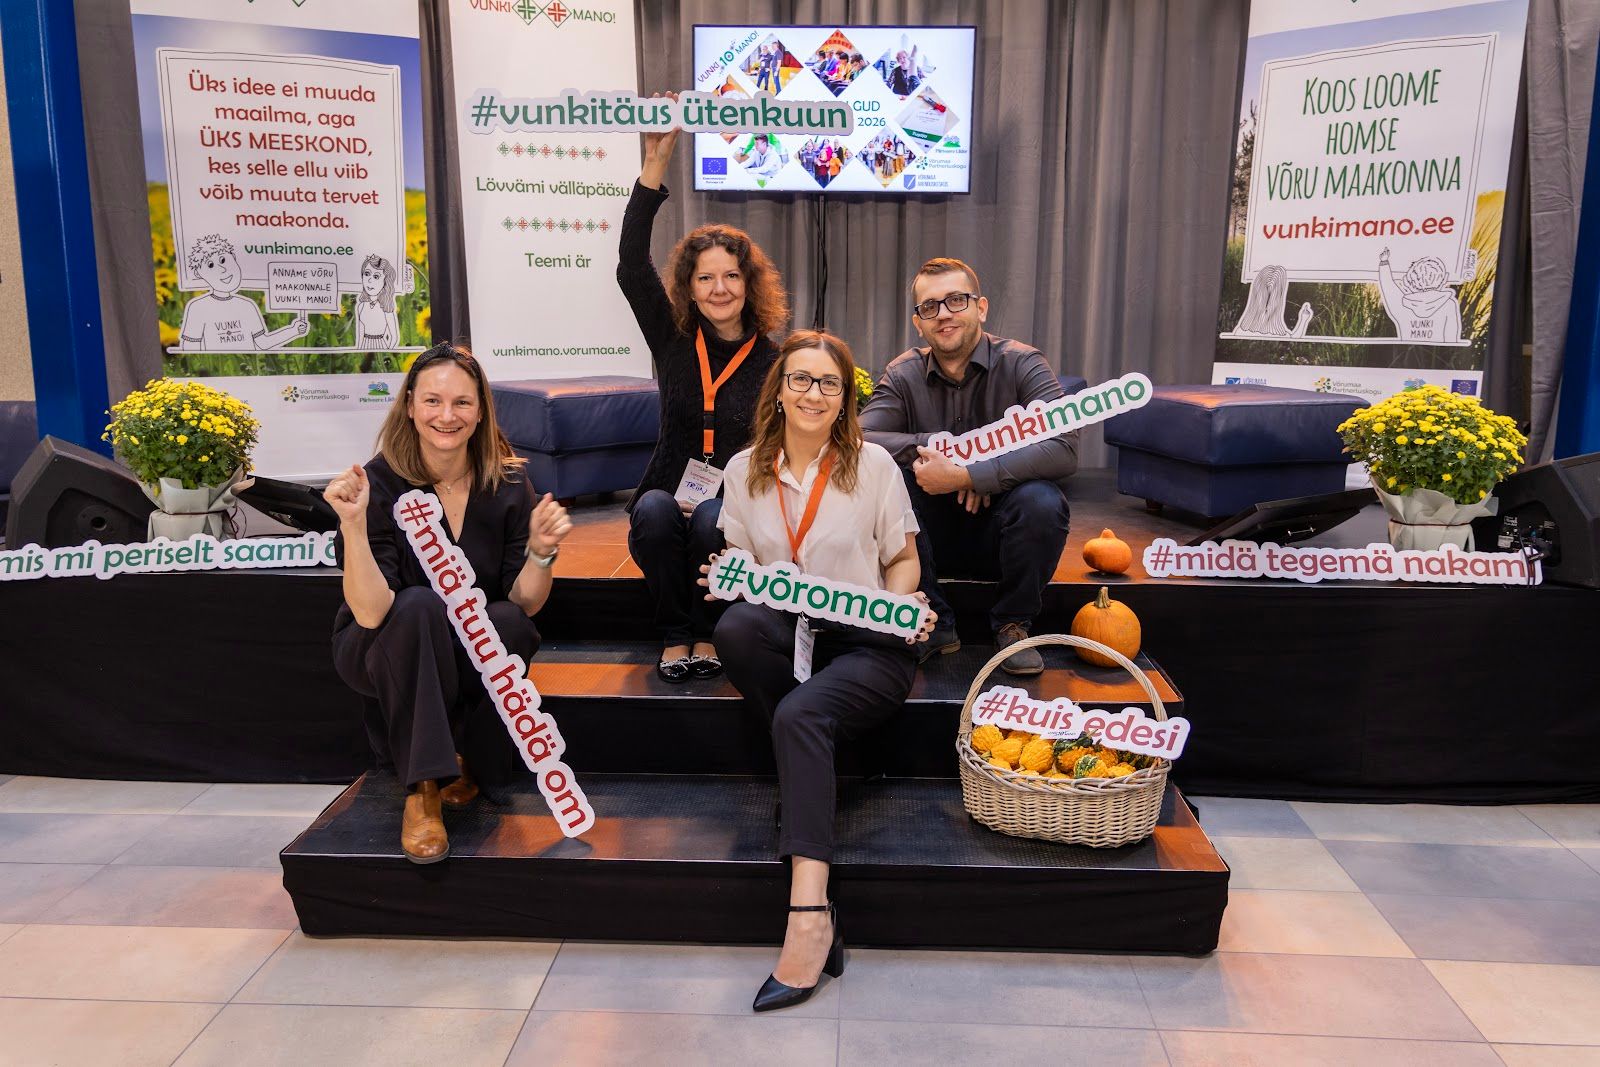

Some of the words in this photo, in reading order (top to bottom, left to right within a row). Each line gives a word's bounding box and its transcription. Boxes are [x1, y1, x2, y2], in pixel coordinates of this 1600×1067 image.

[470, 0, 511, 13] VUNKI
[573, 8, 616, 24] MANO!
[697, 61, 720, 83] VUNKI
[735, 30, 760, 54] MANO!
[188, 69, 227, 93] Üks
[233, 77, 276, 96] idee
[282, 82, 299, 98] ei
[304, 85, 376, 103] muuda
[1302, 75, 1357, 116] KOOS
[1363, 69, 1442, 110] LOOME
[215, 105, 312, 127] maailma,
[318, 111, 356, 129] aga
[471, 95, 673, 127] #vunkitäus
[683, 97, 847, 129] ütenkuun
[857, 117, 886, 127] 2026
[200, 126, 242, 149] ÜKS
[249, 132, 373, 157] MEESKOND,
[1326, 117, 1400, 156] HOMSE
[208, 156, 241, 175] kes
[248, 159, 288, 177] selle
[294, 161, 328, 178] ellu
[334, 163, 368, 180] viib
[1267, 162, 1319, 201] VÕRU
[1324, 156, 1461, 199] MAAKONNA
[200, 183, 244, 202] võib
[250, 187, 317, 203] muuta
[322, 188, 380, 205] tervet
[476, 176, 545, 194] Lövvämi
[549, 180, 630, 198] välläpääsu
[236, 211, 350, 229] maakonda.
[1262, 216, 1455, 240] vunkimano.ee
[243, 242, 355, 256] vunkimano.ee
[524, 252, 571, 268] Teemi
[575, 254, 592, 268] är
[272, 267, 308, 279] ANNAME
[311, 267, 334, 278] VÕRU
[275, 283, 332, 292] MAAKONNALE
[275, 295, 301, 304] VUNKI
[306, 295, 332, 304] MANO!
[214, 319, 242, 331] VUNKI
[1410, 319, 1434, 329] VUNKI
[1410, 329, 1433, 339] MANO
[492, 345, 631, 357] vunkimano.vorumaa.ee
[54, 546, 94, 571] mi
[103, 539, 213, 573] periselt
[223, 538, 315, 563] saami
[1150, 545, 1256, 572] #midä
[1266, 548, 1393, 577] tegemä
[716, 556, 920, 630] #võromaa
[400, 498, 467, 597] #miä
[454, 597, 499, 665] tuu
[489, 663, 557, 764] hädä
[544, 769, 587, 829] om
[978, 692, 1074, 730] #kuis
[1083, 714, 1181, 751] edesi
